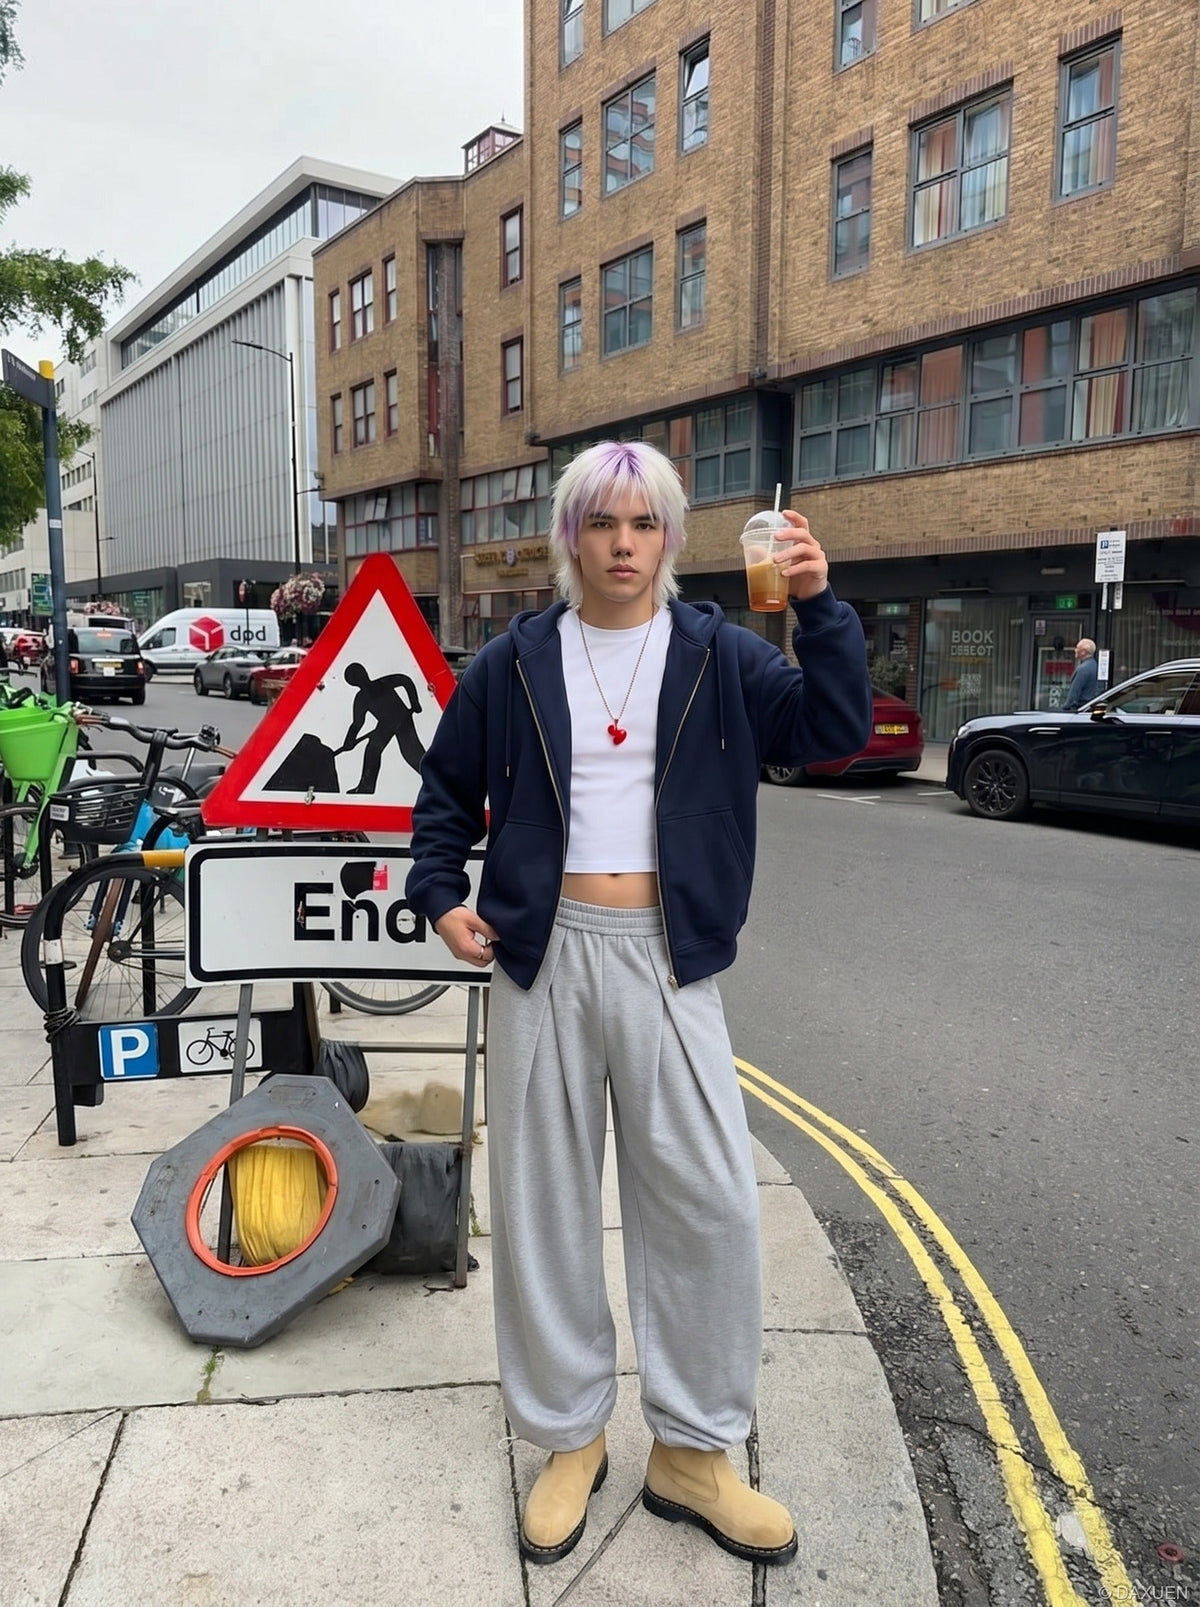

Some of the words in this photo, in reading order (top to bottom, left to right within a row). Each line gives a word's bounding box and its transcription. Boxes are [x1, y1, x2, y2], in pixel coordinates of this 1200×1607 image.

[230, 625, 266, 644] dpd
[952, 630, 994, 643] BOOK
[110, 1028, 149, 1076] P
